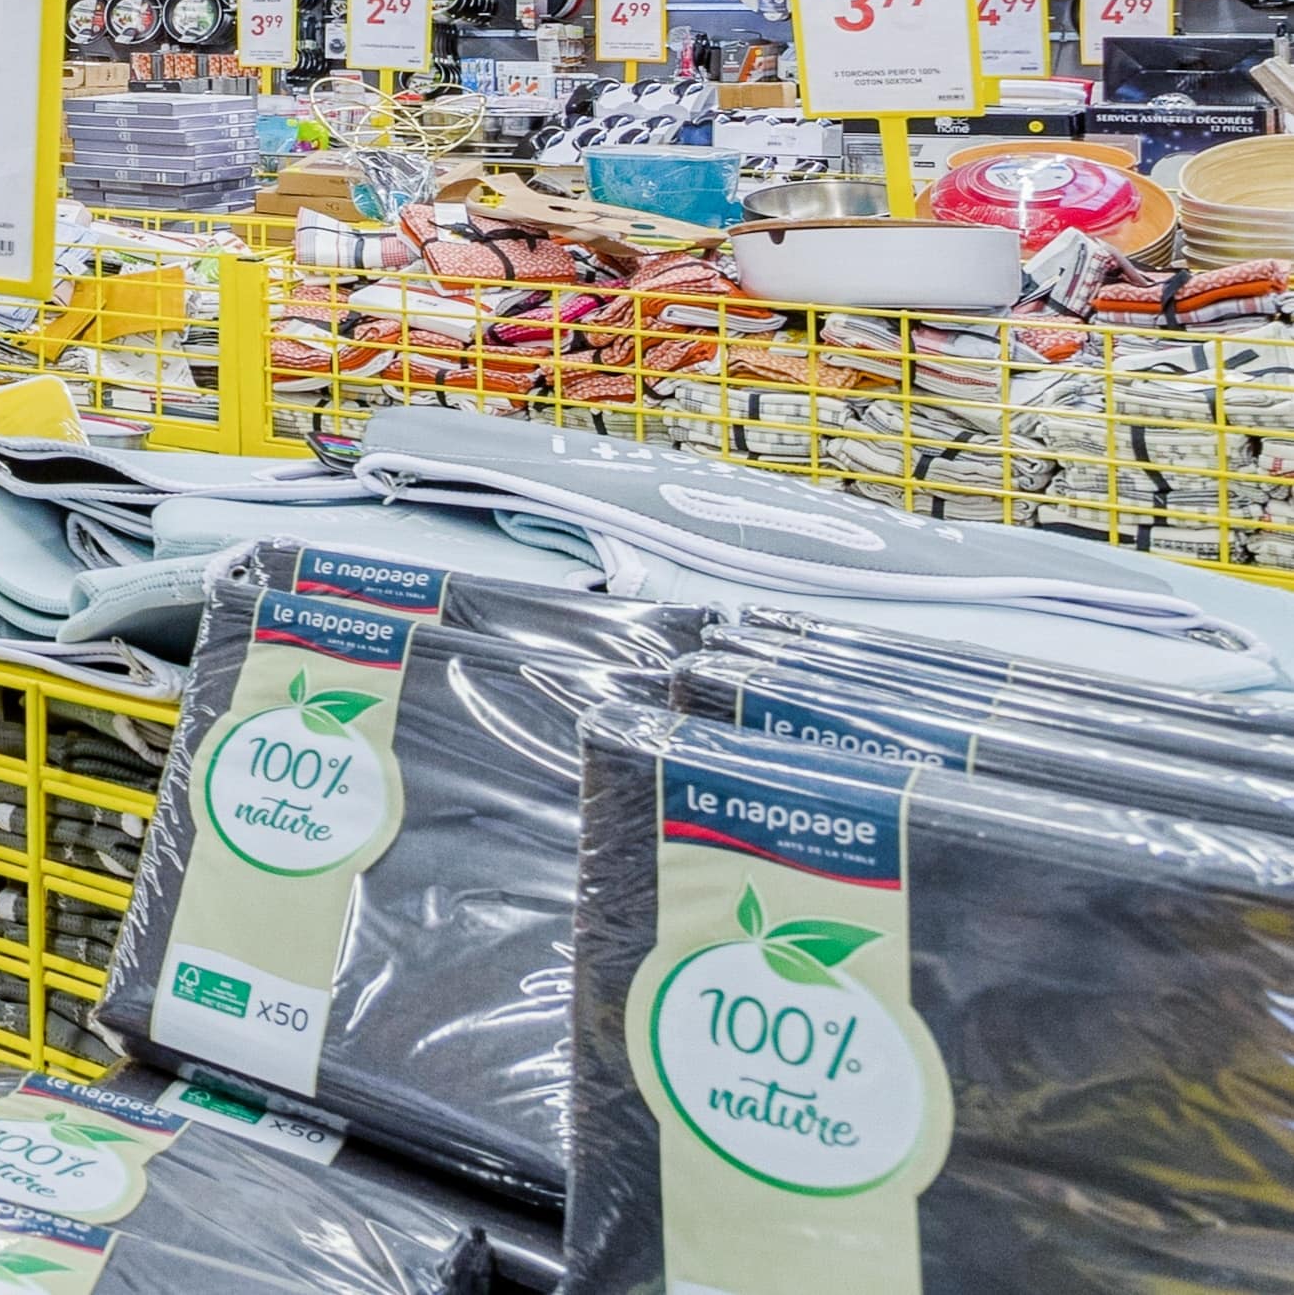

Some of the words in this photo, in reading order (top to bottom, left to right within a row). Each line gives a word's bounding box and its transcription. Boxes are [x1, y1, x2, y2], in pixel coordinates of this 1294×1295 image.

[937, 125, 970, 134] home
[1096, 113, 1138, 123] SERVICE
[314, 557, 332, 575] le
[337, 563, 430, 587] nappage
[273, 604, 293, 623] le
[297, 611, 394, 641] nappage
[764, 711, 793, 737] le
[248, 736, 354, 800] 100%
[234, 796, 333, 843] nature
[687, 784, 719, 814] le
[726, 797, 876, 845] nappage
[256, 1000, 309, 1032] x50
[699, 986, 863, 1081] 100%
[45, 1076, 70, 1092] le
[72, 1080, 174, 1119] nappage
[708, 1076, 861, 1148] nature
[269, 1118, 326, 1144] x50
